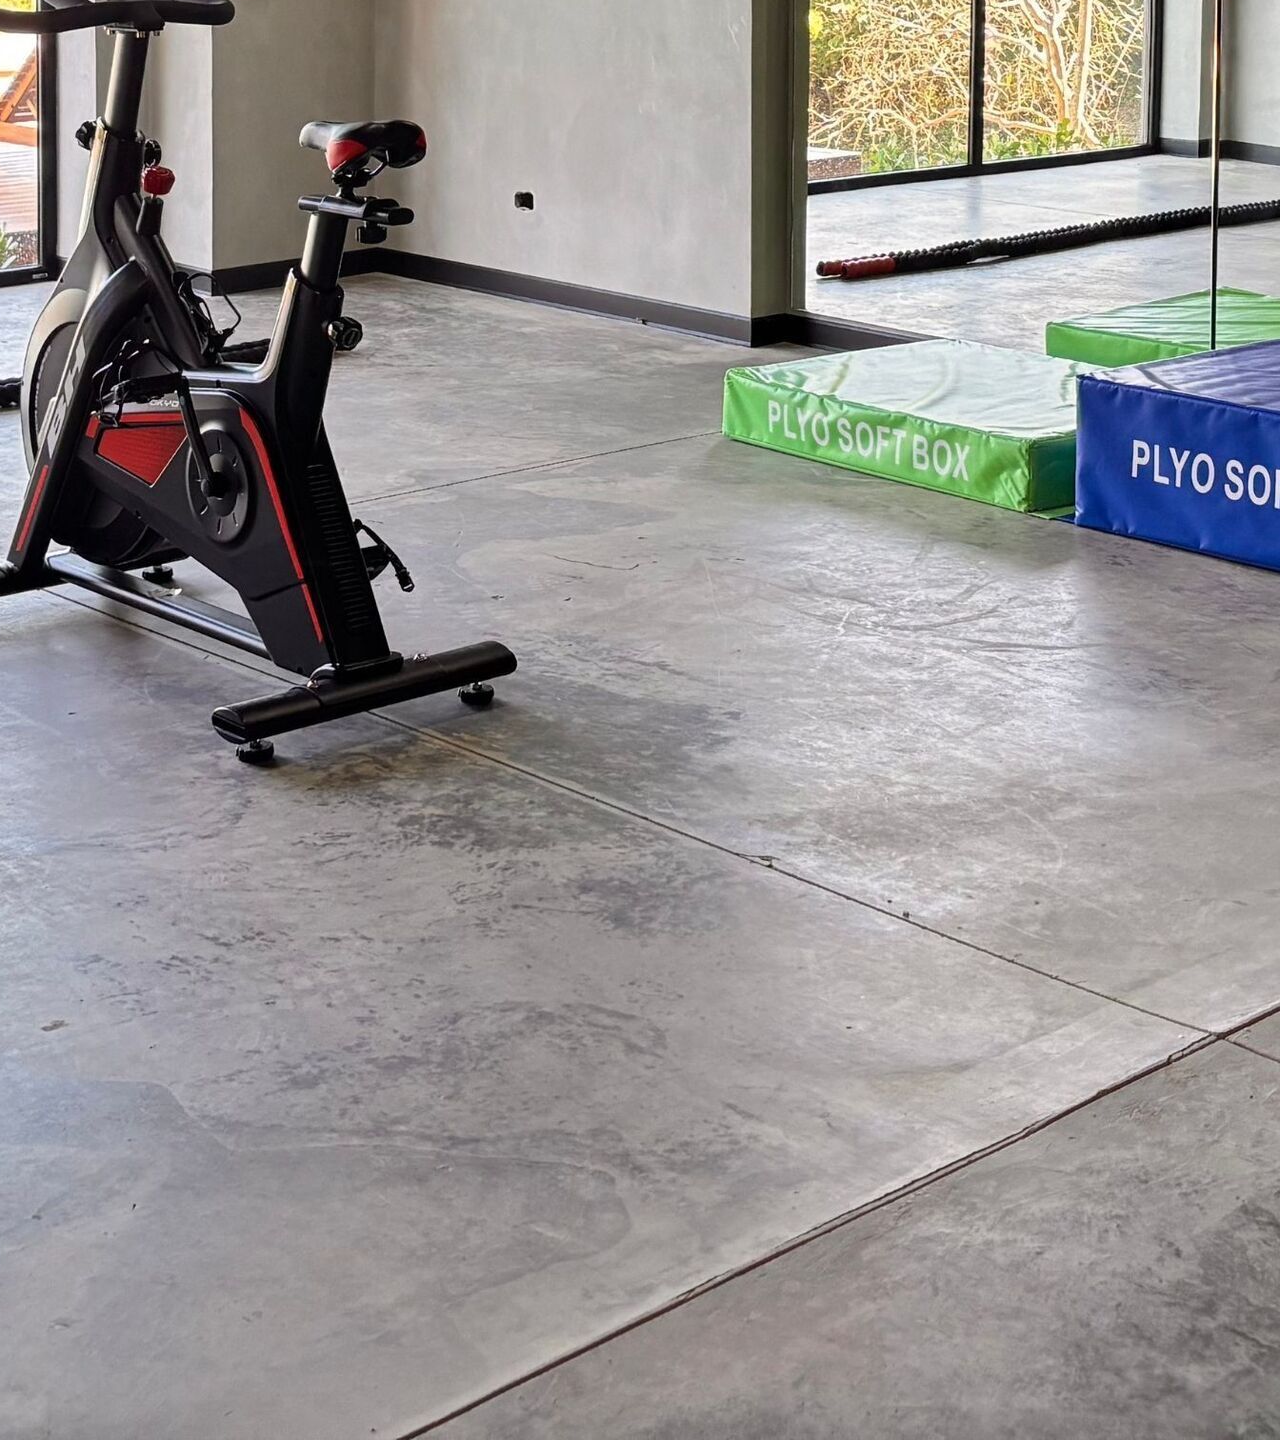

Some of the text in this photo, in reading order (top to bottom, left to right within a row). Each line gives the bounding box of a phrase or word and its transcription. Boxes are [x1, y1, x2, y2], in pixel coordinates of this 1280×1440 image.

[149, 399, 179, 408] OKYO
[767, 399, 971, 482] PLYO SOFT BOX
[1131, 439, 1215, 494] PLYO
